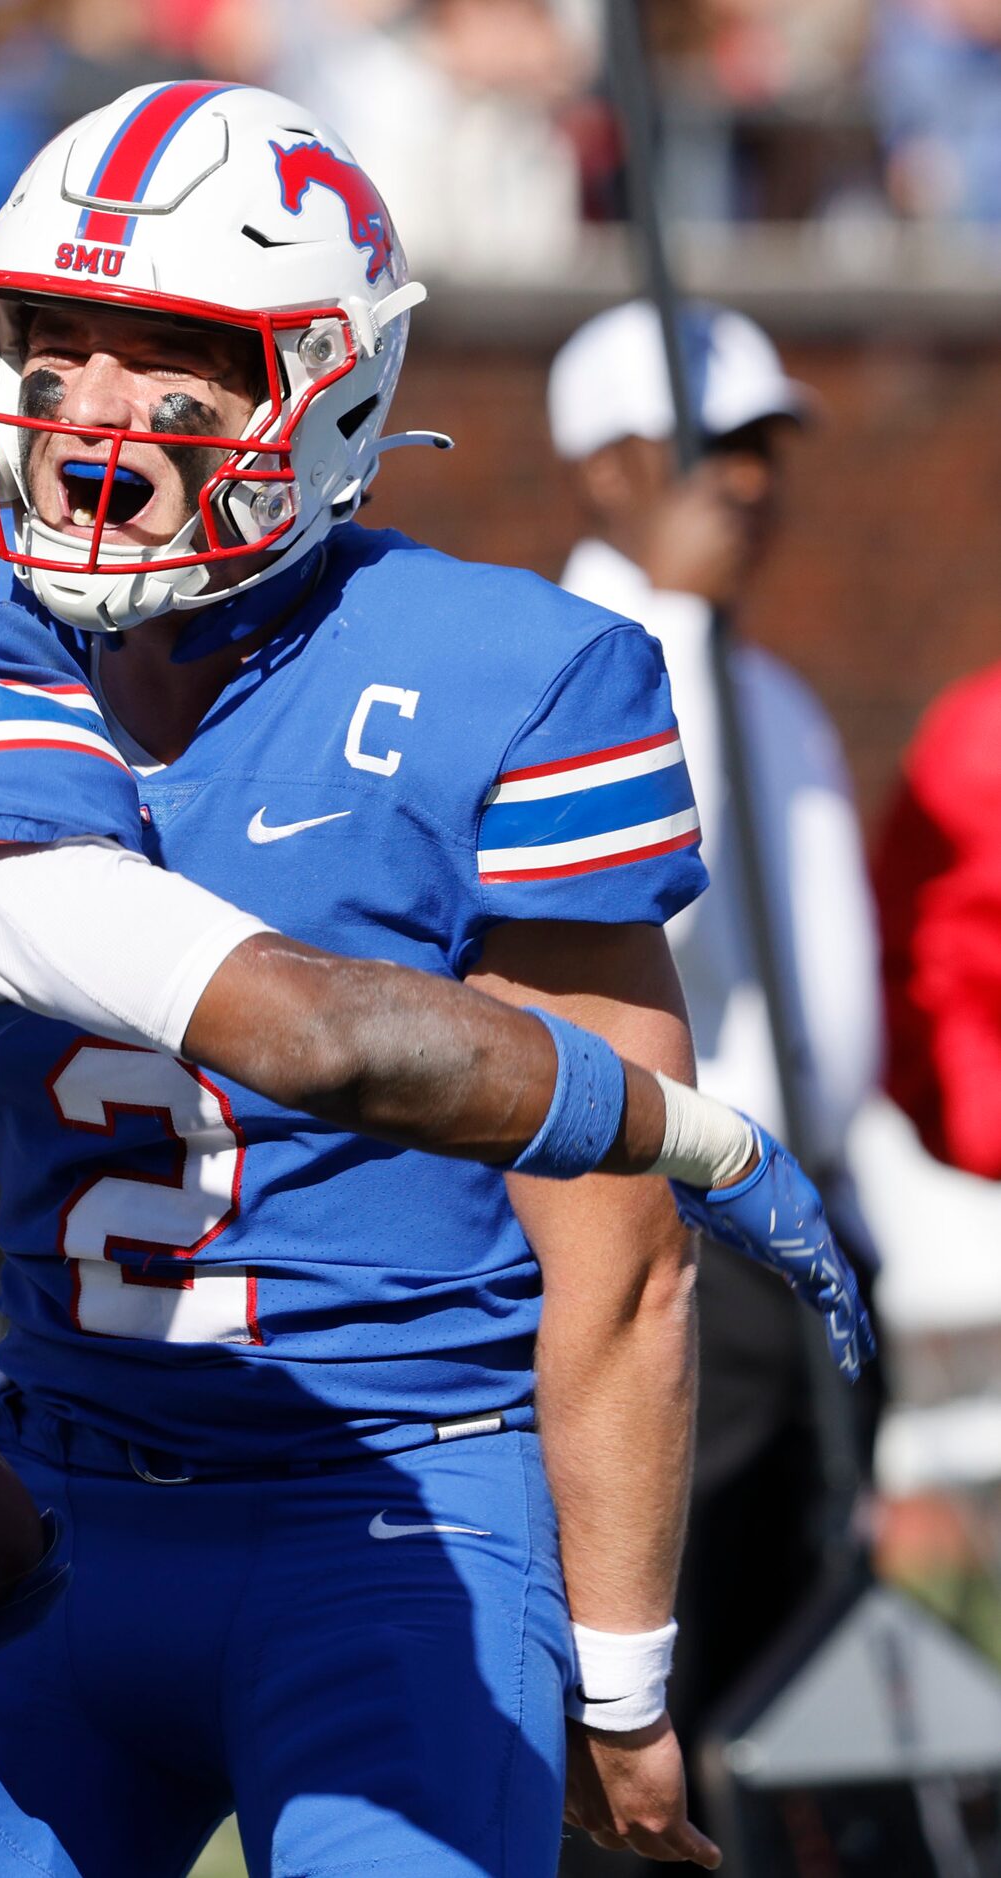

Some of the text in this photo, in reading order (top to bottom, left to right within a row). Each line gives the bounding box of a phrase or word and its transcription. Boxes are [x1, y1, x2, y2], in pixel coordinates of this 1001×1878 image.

[55, 243, 126, 278] SMU
[344, 683, 420, 777] C
[44, 1034, 265, 1346] 2
